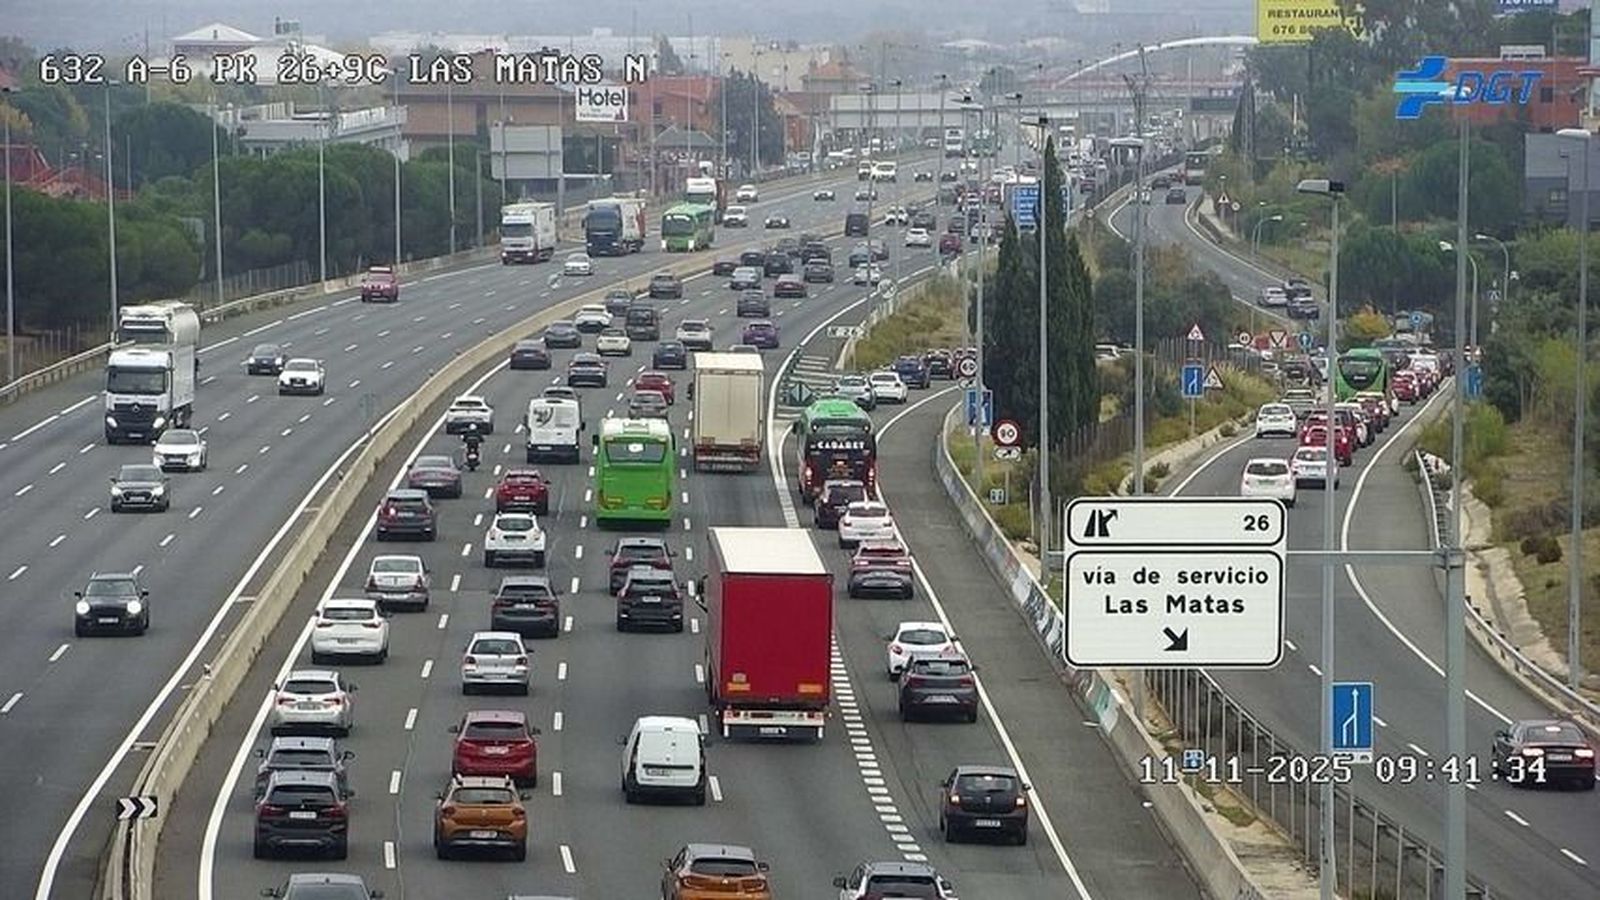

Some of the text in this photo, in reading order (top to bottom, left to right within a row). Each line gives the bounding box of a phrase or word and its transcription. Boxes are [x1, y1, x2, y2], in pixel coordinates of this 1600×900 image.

[1243, 514, 1270, 532] 26
[1083, 566, 1269, 584] vía de servicio
[1105, 595, 1245, 614] Las Matas
